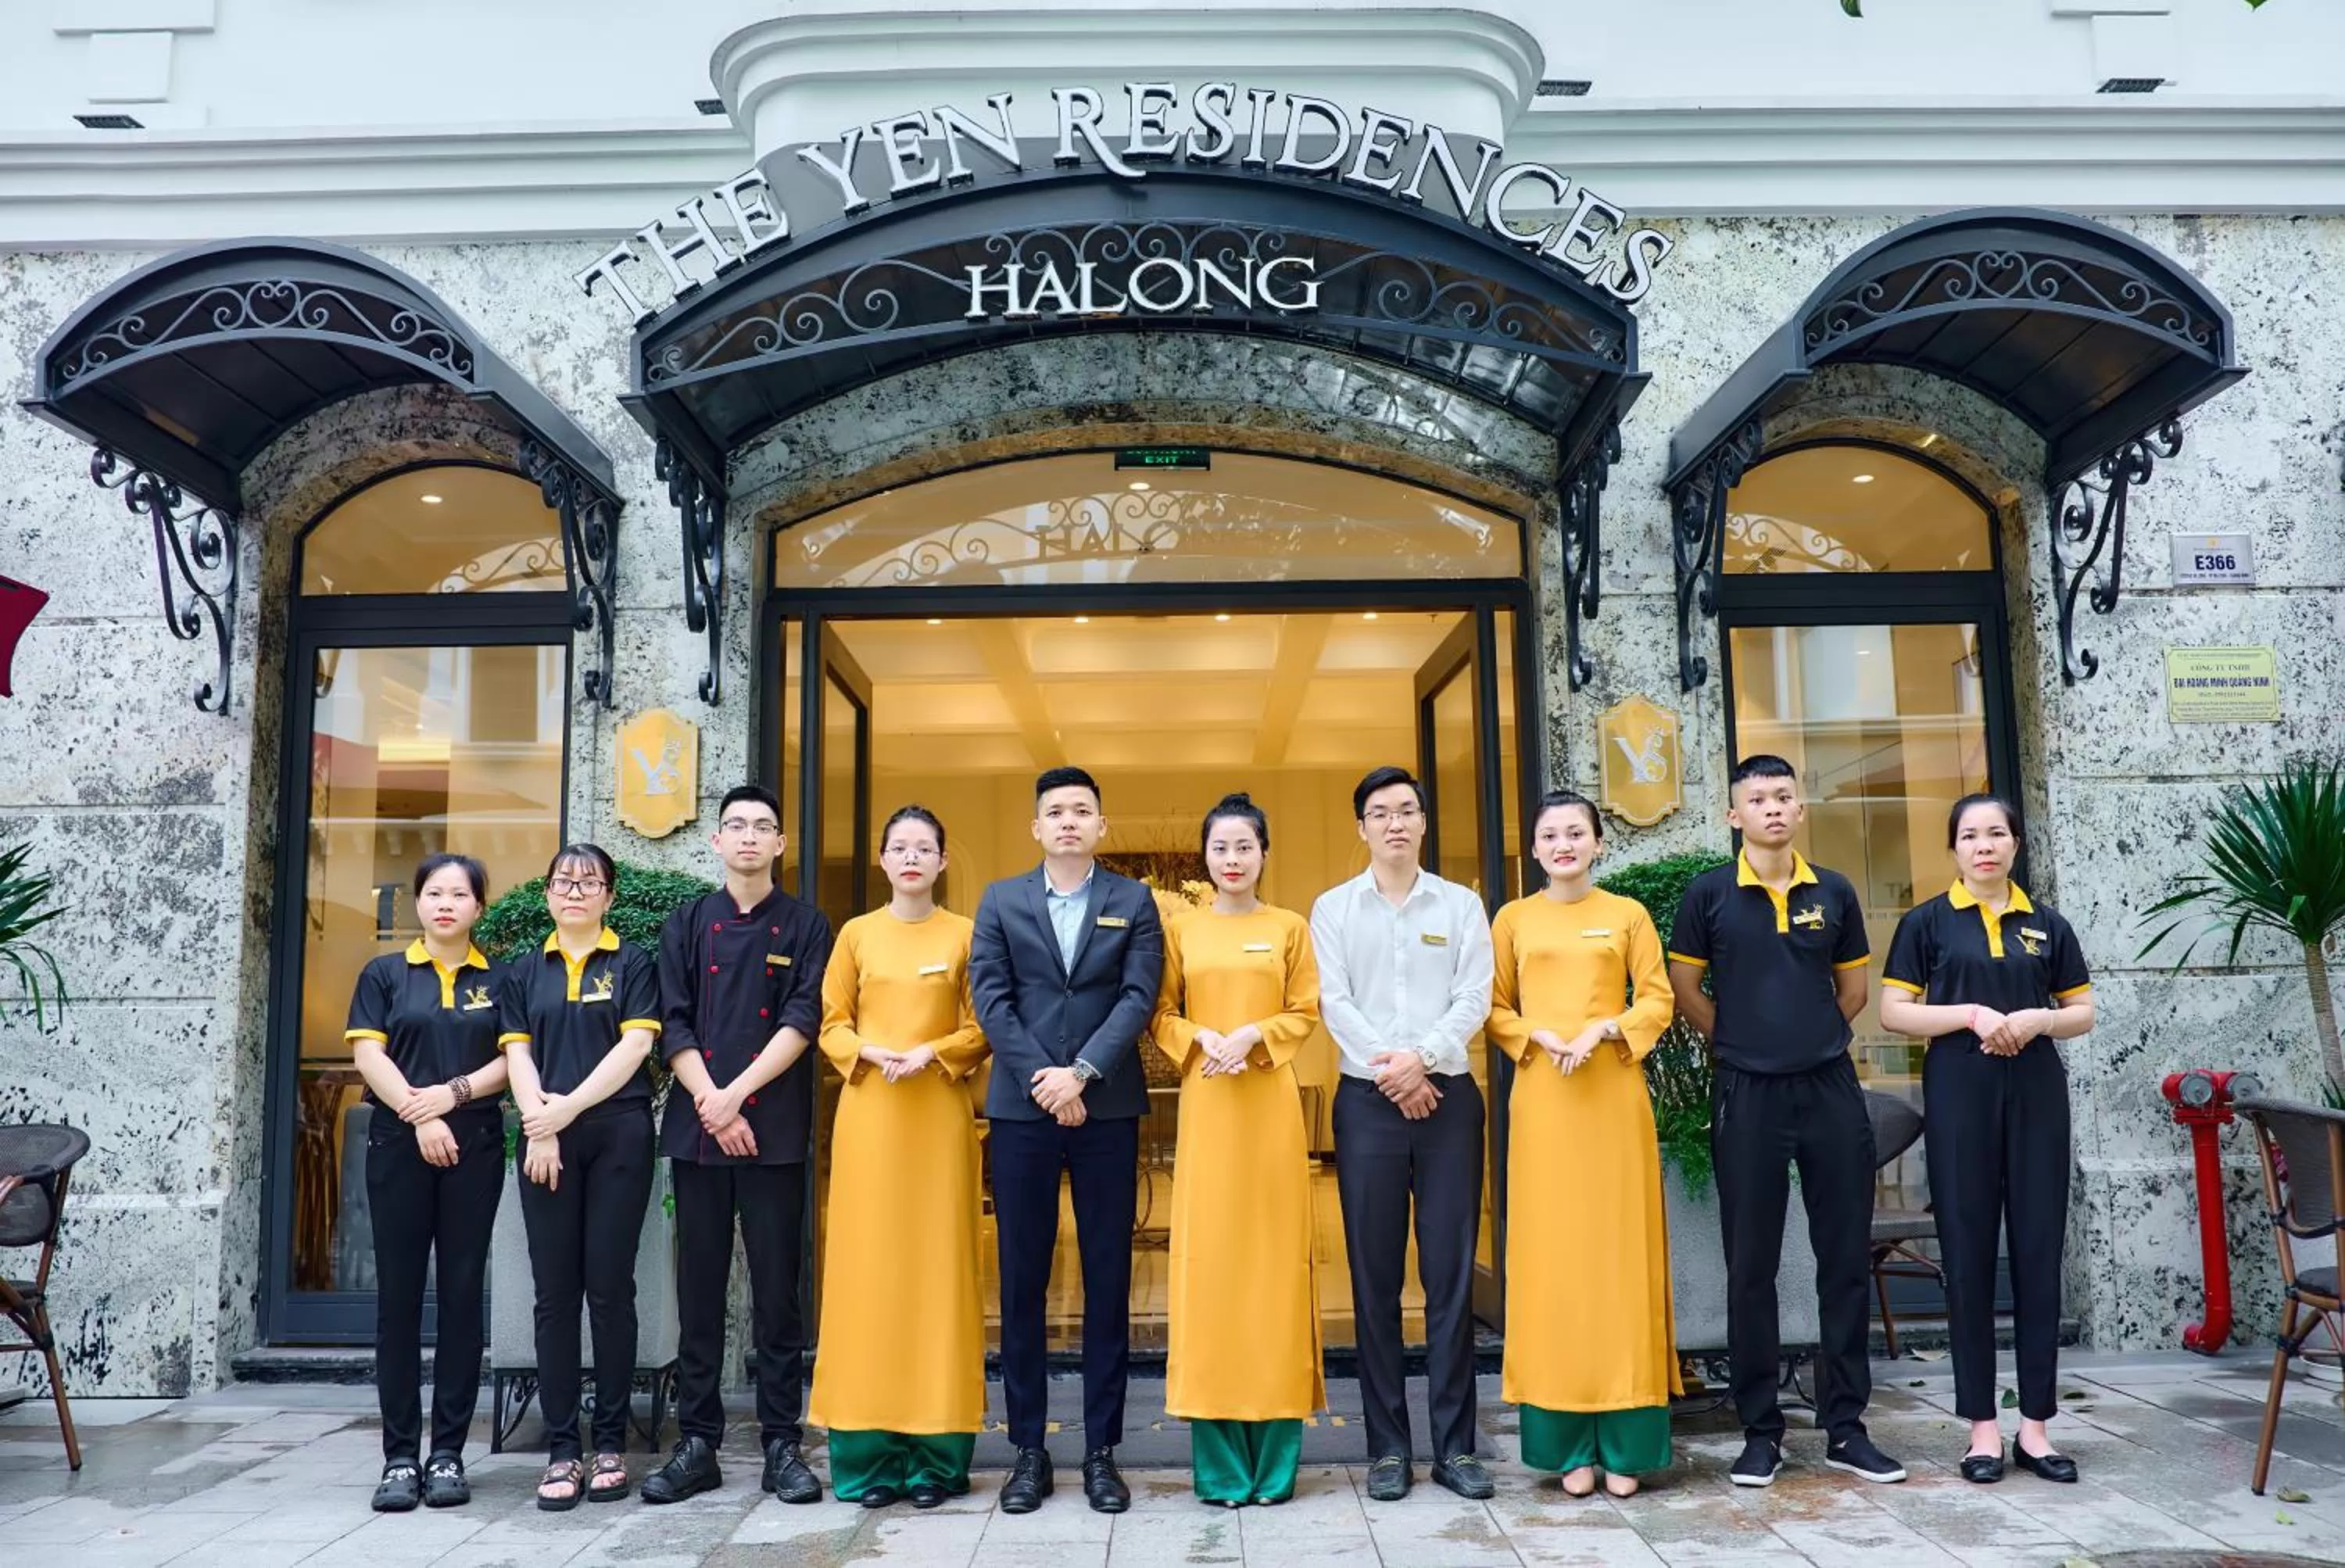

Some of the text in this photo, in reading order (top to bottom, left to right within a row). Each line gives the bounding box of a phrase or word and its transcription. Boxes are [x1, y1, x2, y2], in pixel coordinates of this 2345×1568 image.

[572, 81, 1674, 330] THE YEN RESIDENCES
[964, 256, 1321, 320] HALONG
[2195, 554, 2236, 571] E366
